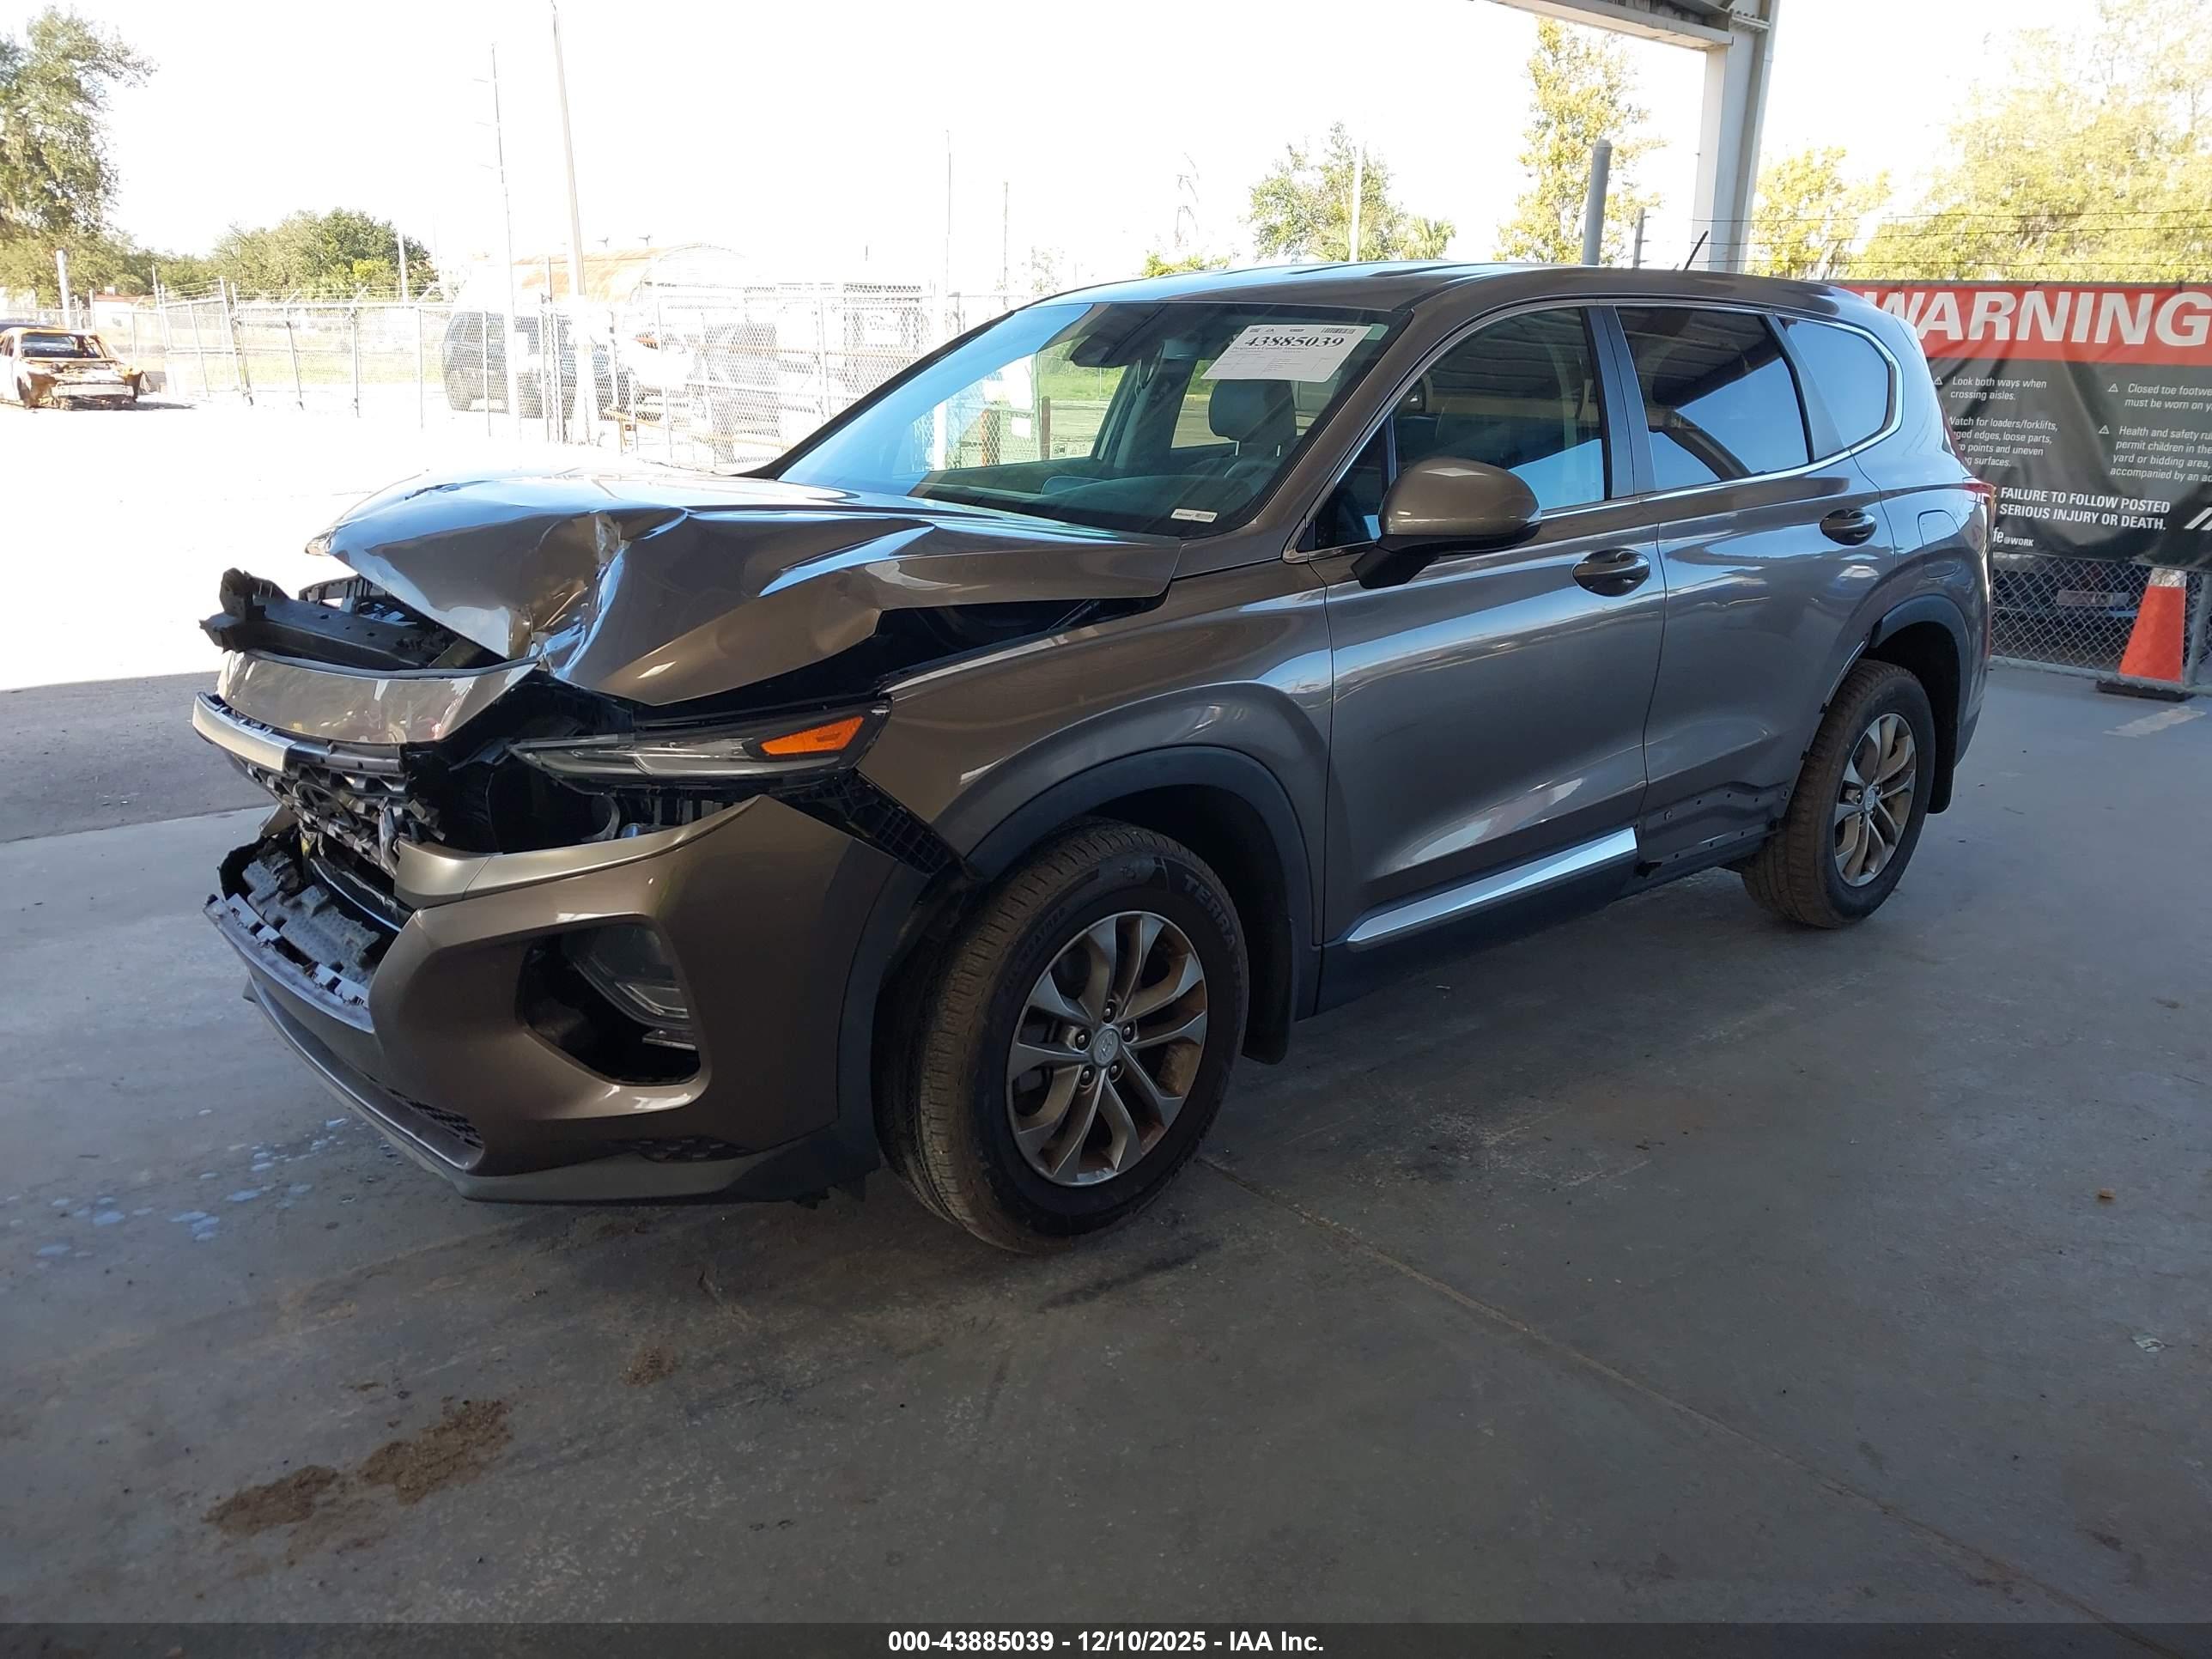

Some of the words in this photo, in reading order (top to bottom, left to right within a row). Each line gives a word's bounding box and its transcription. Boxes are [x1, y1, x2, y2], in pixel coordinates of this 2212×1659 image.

[1245, 336, 1345, 348] 43885039
[1953, 376, 1973, 386] Look
[1976, 377, 1996, 386] both
[1997, 380, 2020, 389] ways
[2023, 379, 2047, 388] when
[2128, 383, 2160, 394] Closed
[2161, 386, 2177, 395] toe
[1950, 390, 1987, 401] crossing
[1990, 391, 2016, 400] aisles.
[2124, 398, 2148, 408] must
[2150, 398, 2162, 408] be
[2164, 401, 2189, 410] worn
[2191, 402, 2203, 410] on
[1976, 416, 1989, 427] for
[1990, 418, 2057, 432] loaders/forklifts,
[1974, 430, 2002, 441] edges,
[2003, 432, 2026, 441] loose
[2027, 434, 2053, 445] parts,
[2118, 425, 2148, 436] Health
[2151, 428, 2169, 438] and
[2170, 429, 2199, 442] safety
[1967, 442, 1994, 453] points
[1996, 444, 2010, 453] and
[2012, 447, 2044, 456] uneven
[2115, 440, 2146, 451] permit
[2148, 441, 2184, 453] children
[2185, 443, 2195, 453] in
[2197, 444, 2212, 454] the
[1974, 456, 2012, 467] surfaces.
[2113, 453, 2136, 464] yard
[2150, 455, 2185, 469] bidding
[2187, 459, 2211, 470] area,
[2110, 467, 2172, 479] accompanied
[2174, 471, 2186, 482] by
[2000, 487, 2048, 502] FAILURE
[2051, 491, 2067, 504] TO
[2069, 493, 2118, 509] FOLLOW
[2120, 497, 2171, 514] POSTED
[1999, 503, 2050, 520] SERIOUS
[2053, 507, 2099, 525] INJURY
[2101, 513, 2118, 526] OR
[2121, 515, 2166, 530] DEATH.
